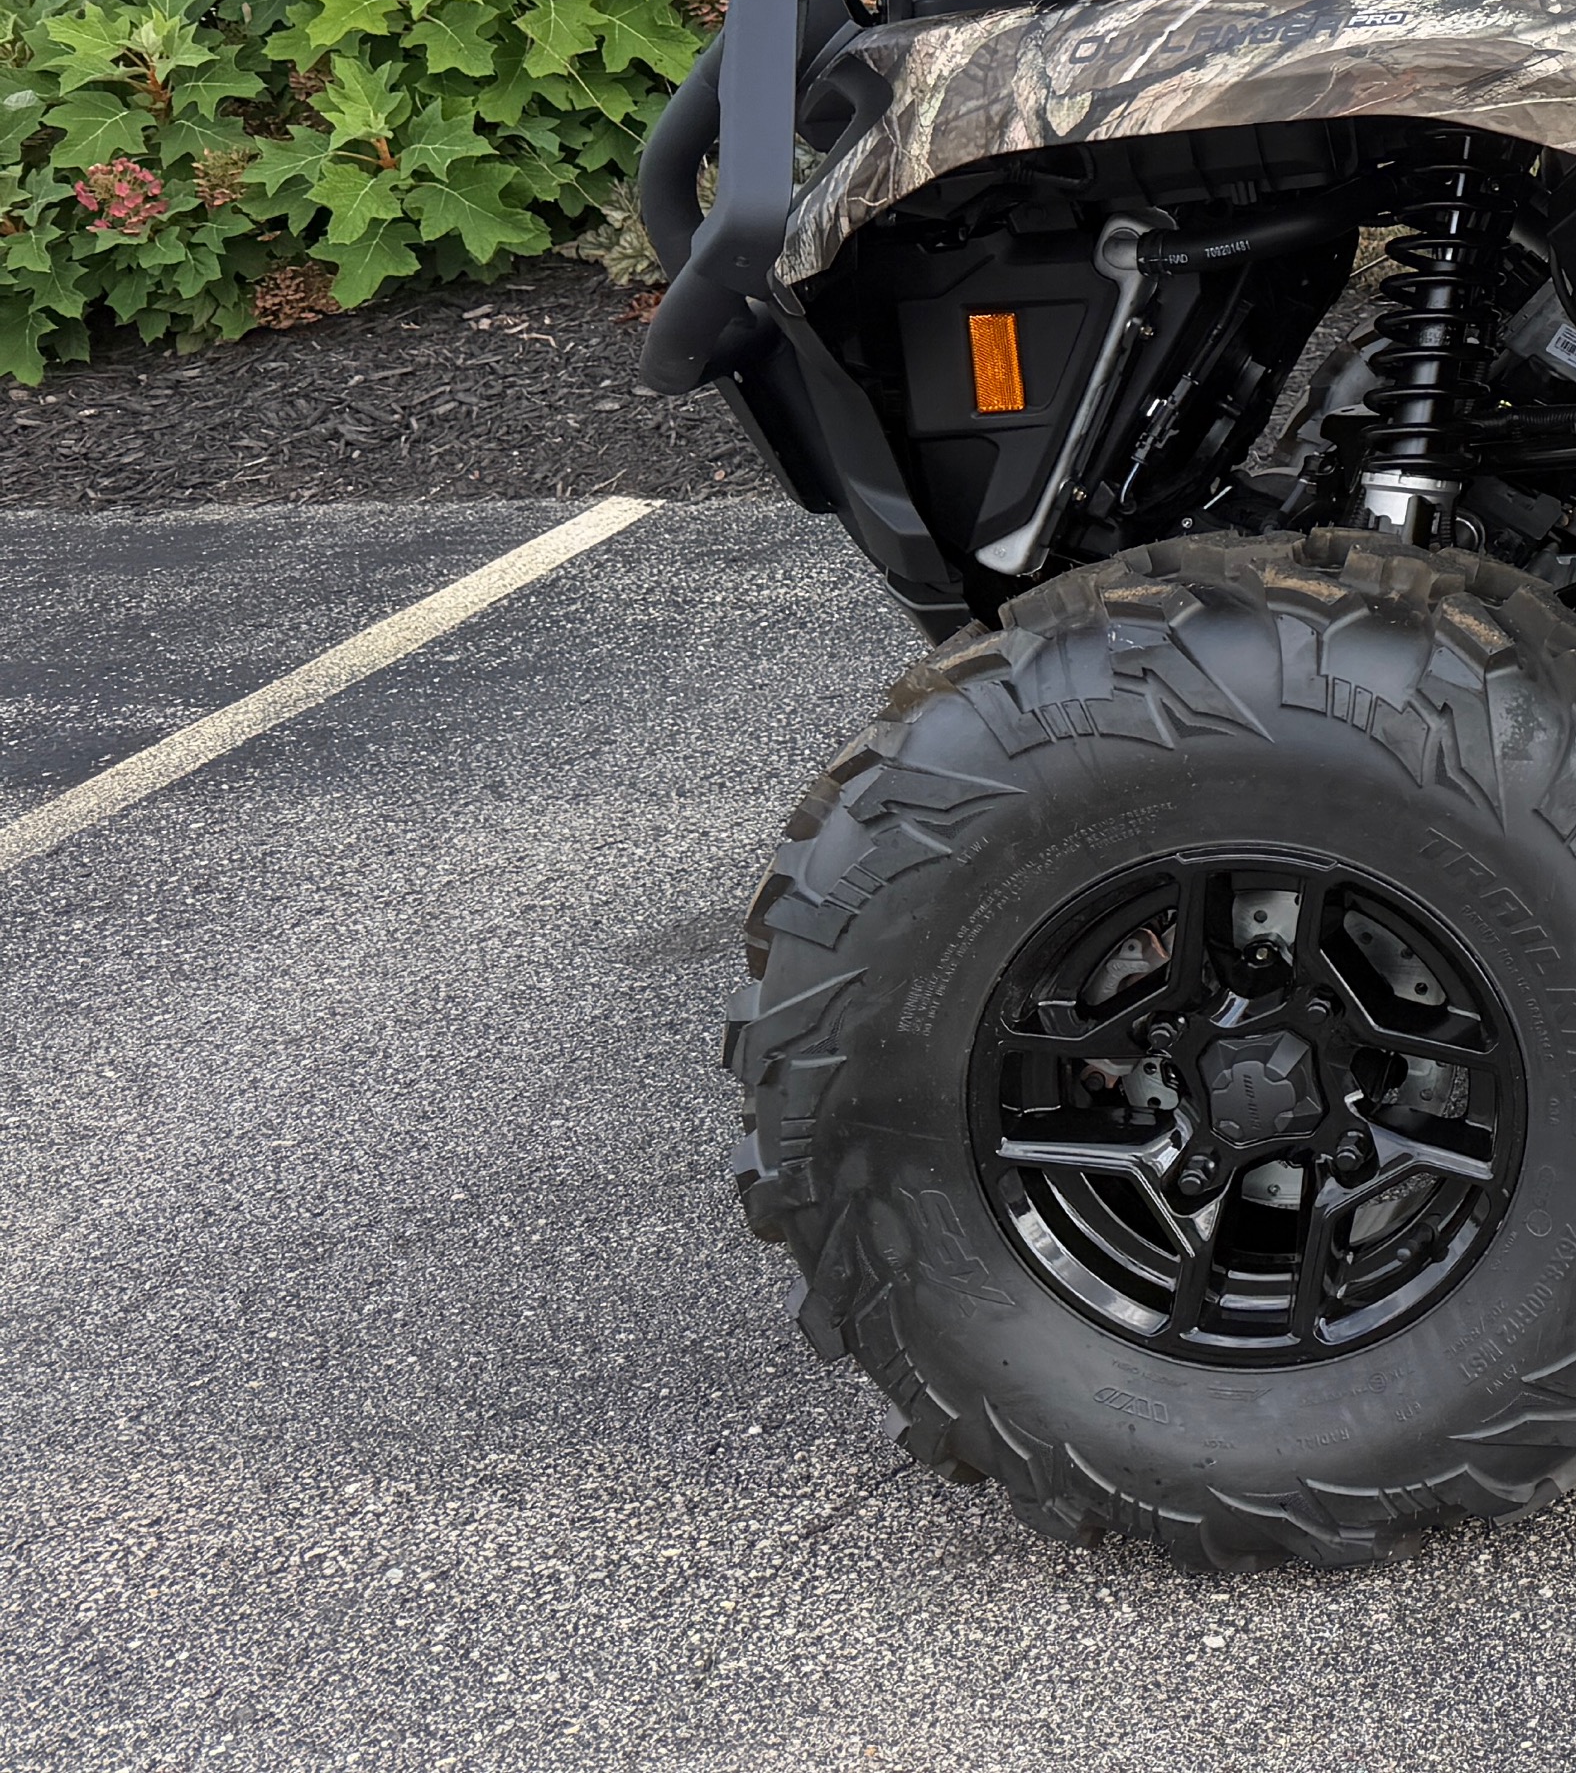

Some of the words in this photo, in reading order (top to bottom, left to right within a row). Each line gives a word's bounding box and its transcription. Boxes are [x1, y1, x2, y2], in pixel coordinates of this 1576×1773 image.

[1068, 11, 1349, 65] OUTLANDER
[1349, 11, 1404, 27] PRO
[1413, 824, 1565, 978] TRAIL
